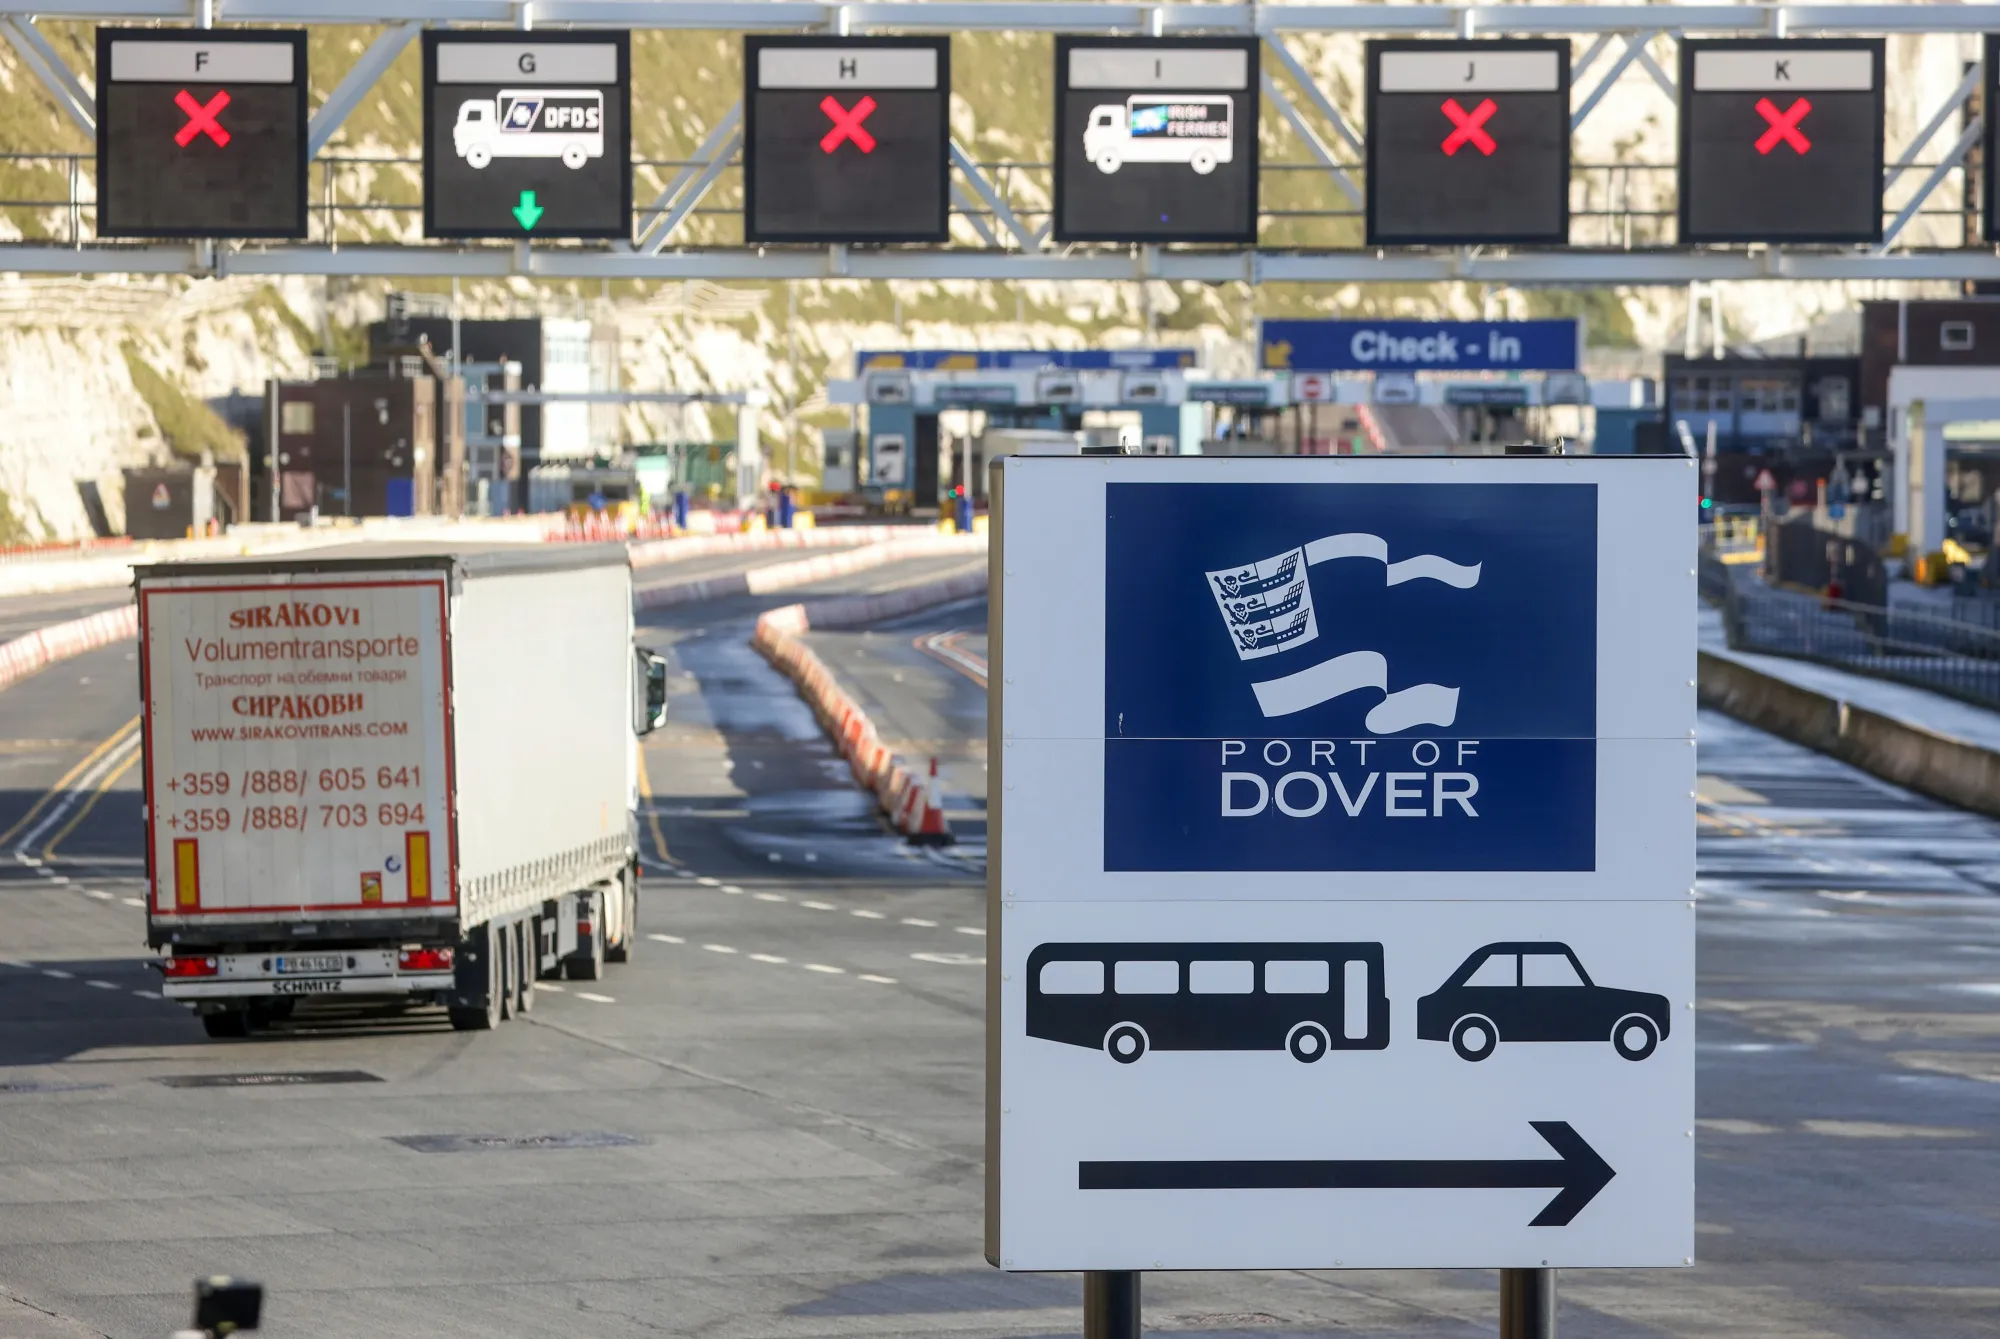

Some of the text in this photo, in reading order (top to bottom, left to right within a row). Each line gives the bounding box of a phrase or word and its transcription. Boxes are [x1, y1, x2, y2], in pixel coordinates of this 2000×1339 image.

[195, 51, 209, 72] F
[518, 52, 536, 74] G
[838, 59, 857, 79] H
[1155, 58, 1161, 79] I
[1463, 61, 1475, 82] J
[1774, 60, 1790, 81] K
[544, 107, 599, 129] DFDS
[1168, 105, 1208, 120] IRISH
[1167, 121, 1227, 136] FERRIES
[1351, 329, 1459, 362] Check
[1488, 331, 1521, 361] in
[229, 602, 361, 630] SIRAKOVI
[185, 634, 419, 665] Volumentransporte
[197, 672, 272, 690] Транспорт
[278, 673, 295, 686] на
[358, 668, 407, 685] товари
[232, 692, 363, 720] СИРАКОВИ
[191, 721, 408, 742] WWW.SIRAKOVITRANS.COM
[1221, 740, 1480, 767] PORT OF
[166, 765, 421, 797] +359 /888/ 605 641
[1221, 771, 1480, 818] DOVER
[167, 802, 425, 832] +359 /888/ 703 694
[272, 980, 341, 994] SCHMITZ
